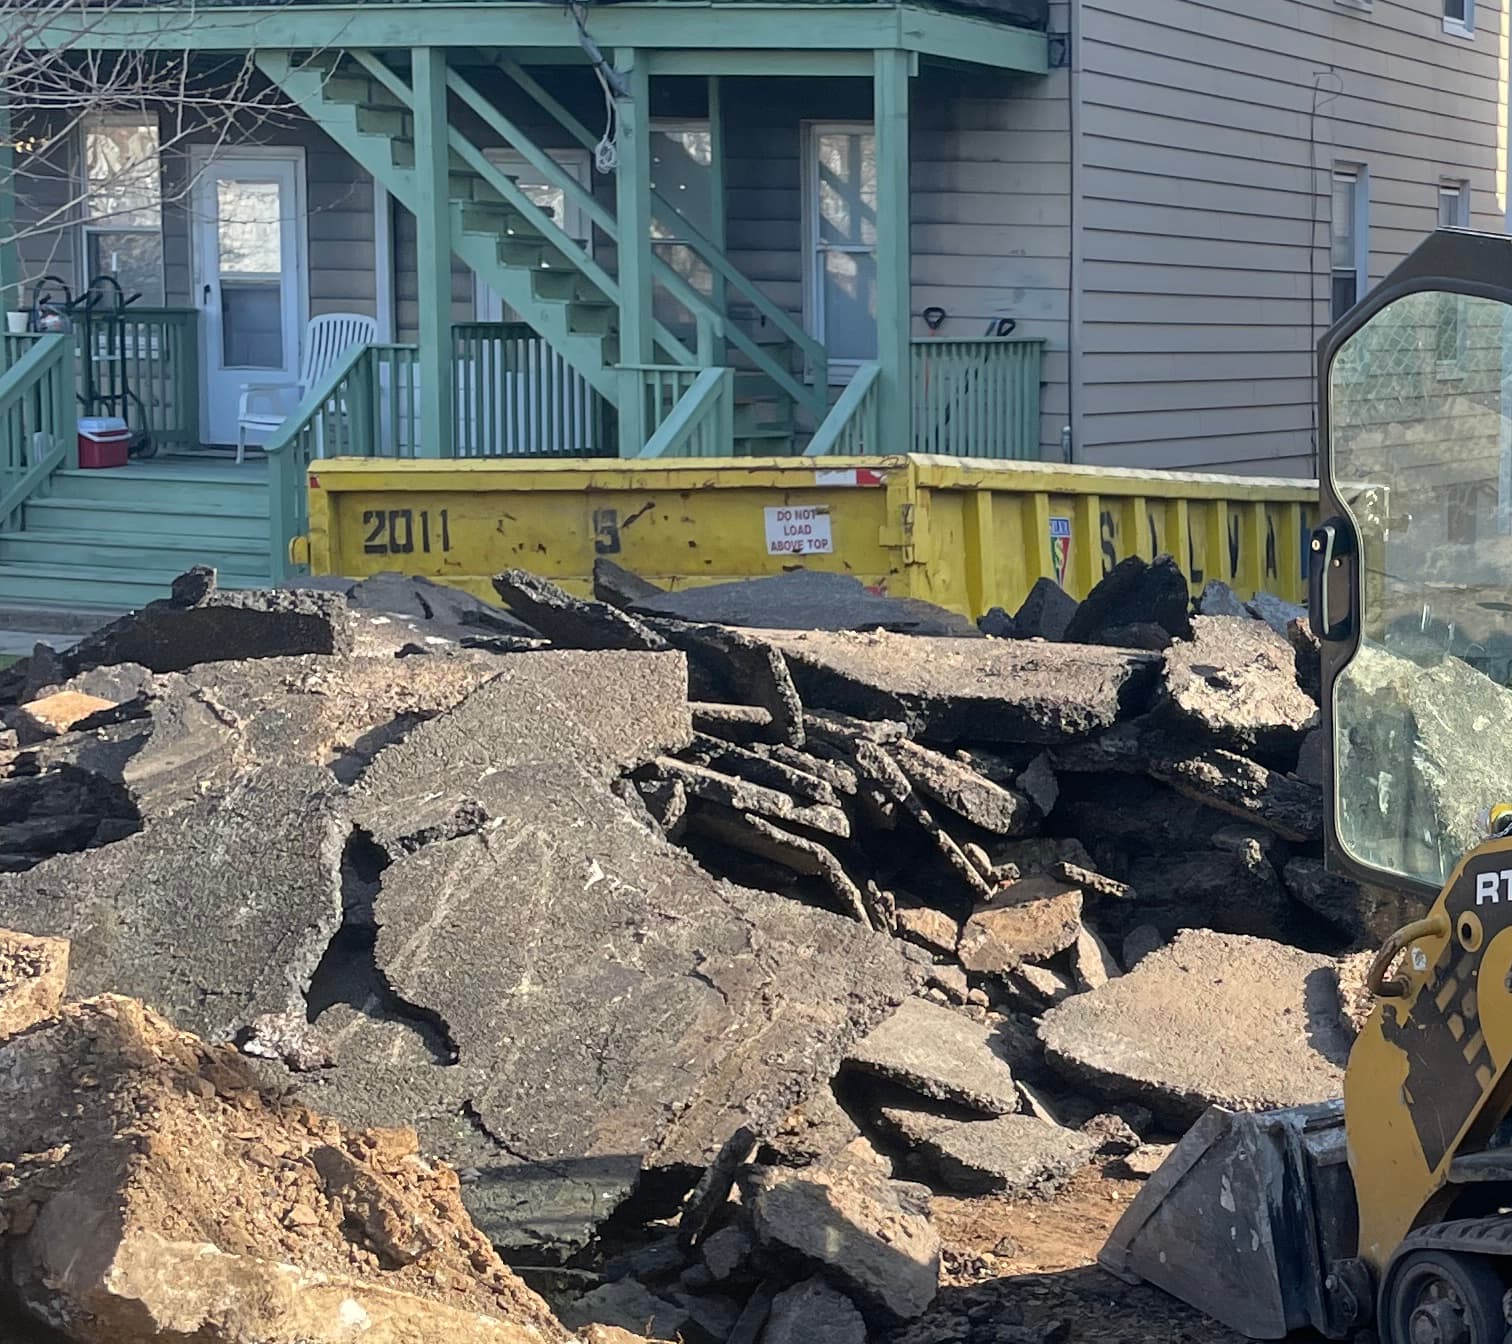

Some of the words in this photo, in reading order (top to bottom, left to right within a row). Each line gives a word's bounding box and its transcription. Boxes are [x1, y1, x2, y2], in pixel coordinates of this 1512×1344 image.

[776, 510, 792, 522] DO
[794, 508, 817, 521] NOT
[362, 508, 451, 554] 2011
[783, 524, 812, 537] LOAD
[770, 539, 804, 553] ABOVE
[807, 538, 829, 550] TOP
